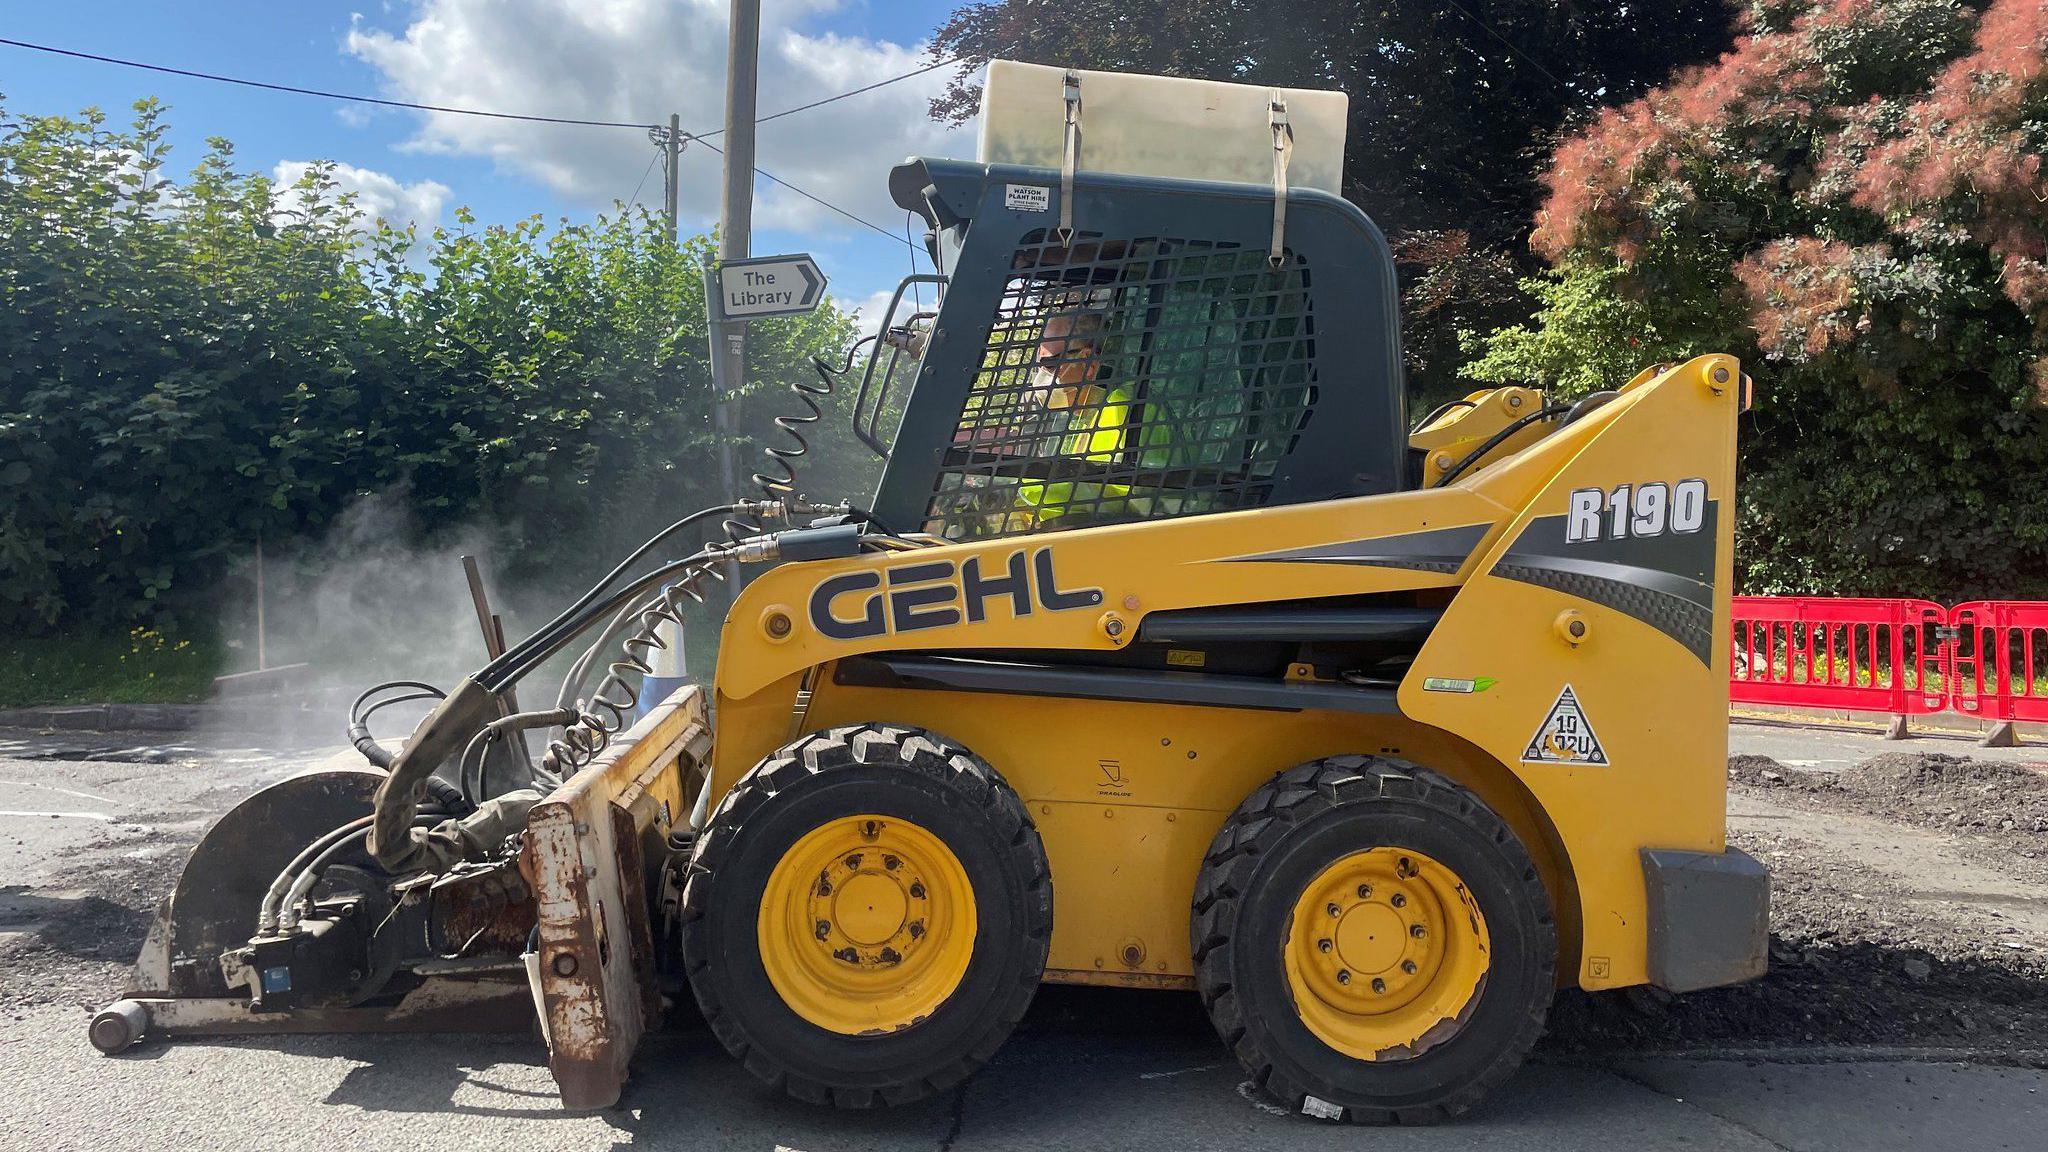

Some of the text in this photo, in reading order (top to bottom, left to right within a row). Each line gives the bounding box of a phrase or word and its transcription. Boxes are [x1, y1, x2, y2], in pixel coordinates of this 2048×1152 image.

[1008, 193, 1030, 201] PLANT
[1013, 188, 1042, 196] WATSON
[743, 271, 776, 286] The
[731, 291, 792, 307] Library
[1566, 478, 1709, 543] R190
[808, 546, 1104, 639] GEHL
